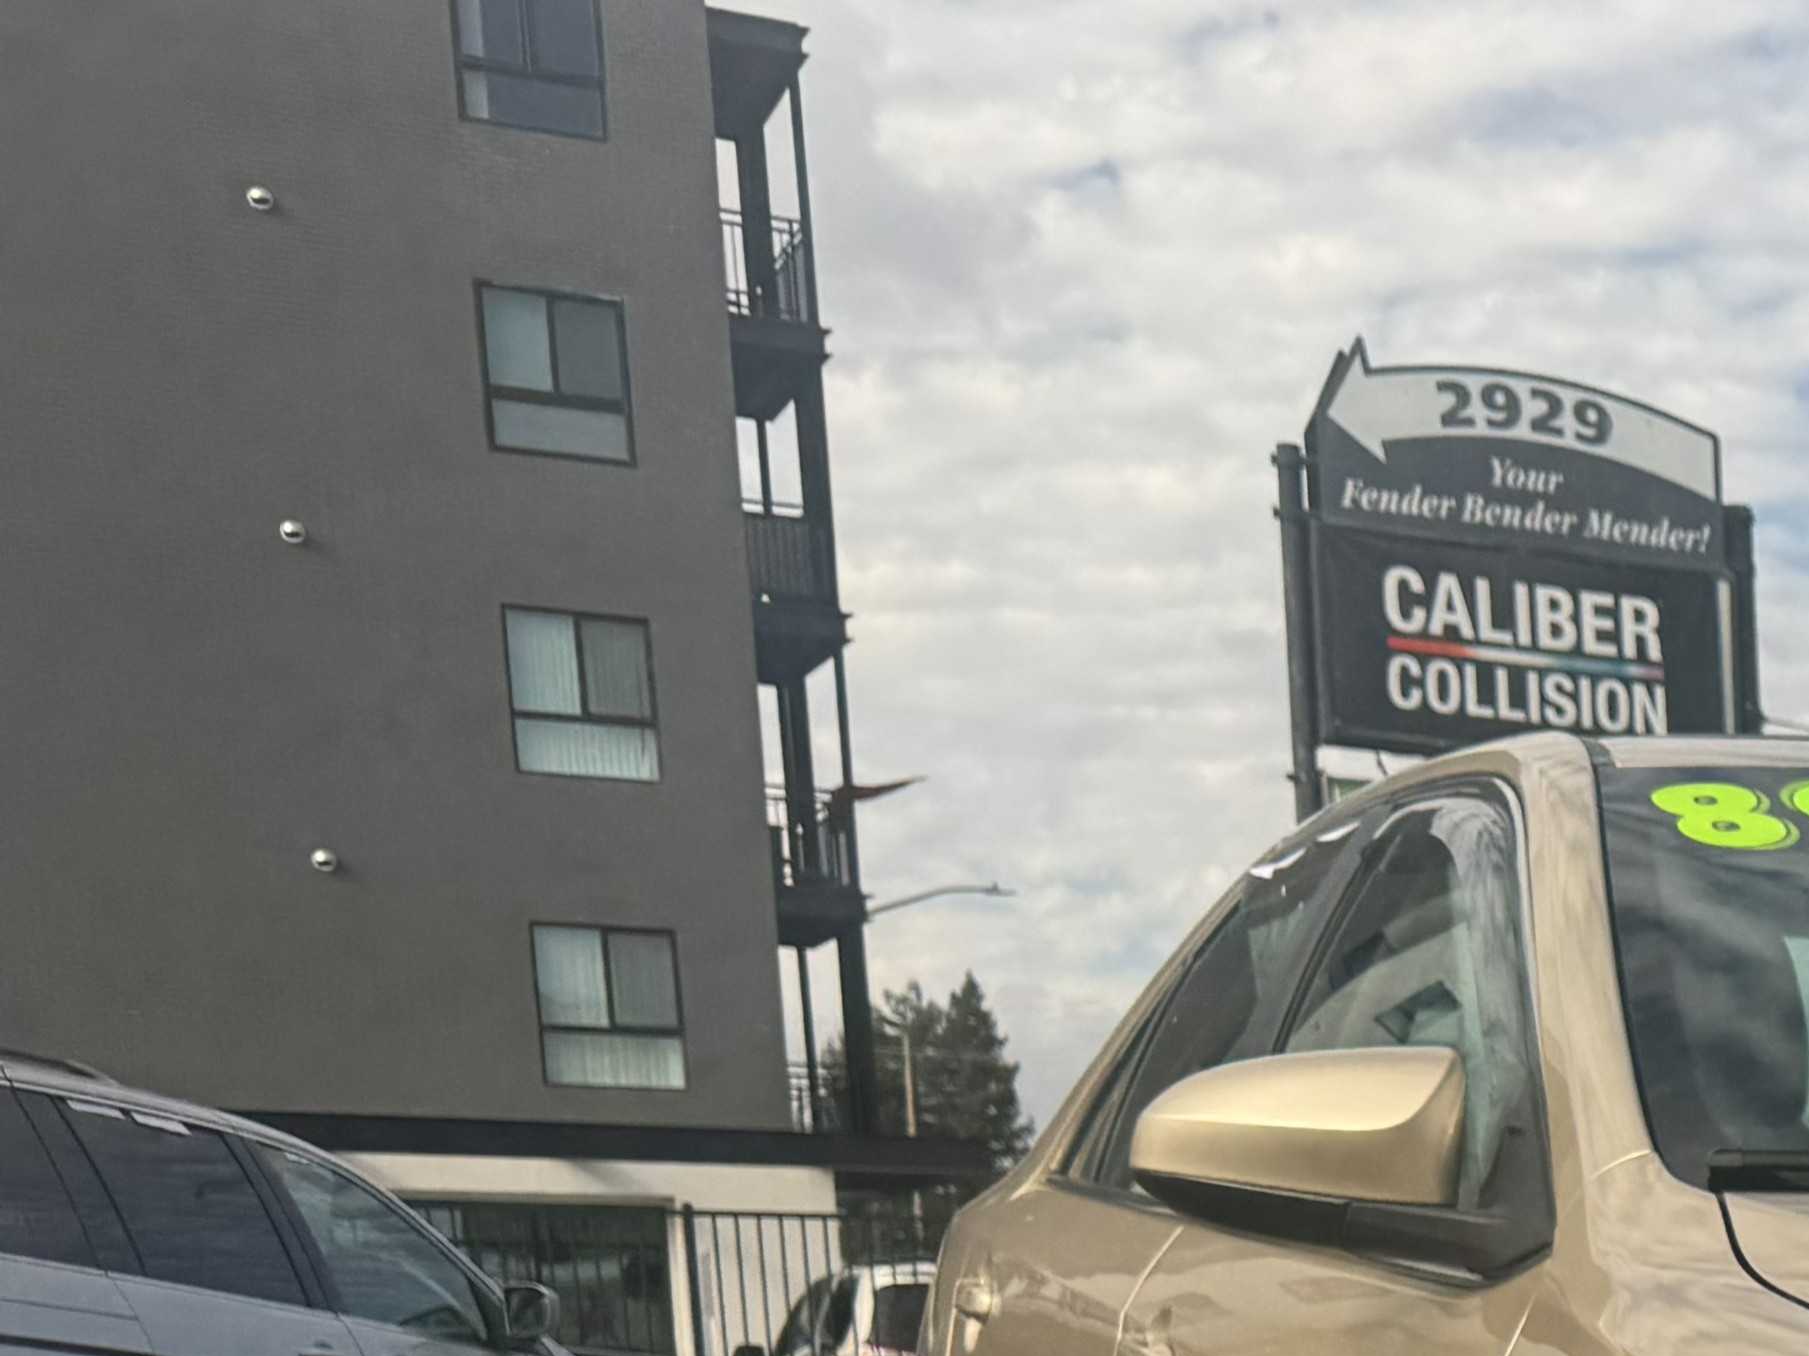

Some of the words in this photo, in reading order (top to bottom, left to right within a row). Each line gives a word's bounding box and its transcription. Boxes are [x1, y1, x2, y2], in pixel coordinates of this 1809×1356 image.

[1435, 380, 1613, 447] 2929
[1490, 456, 1564, 493] Your
[1341, 477, 1456, 519] Fender
[1461, 494, 1578, 536] Bender
[1583, 508, 1711, 554] Mender!
[1382, 565, 1664, 664] CALIBER
[1387, 655, 1668, 735] COLLISION
